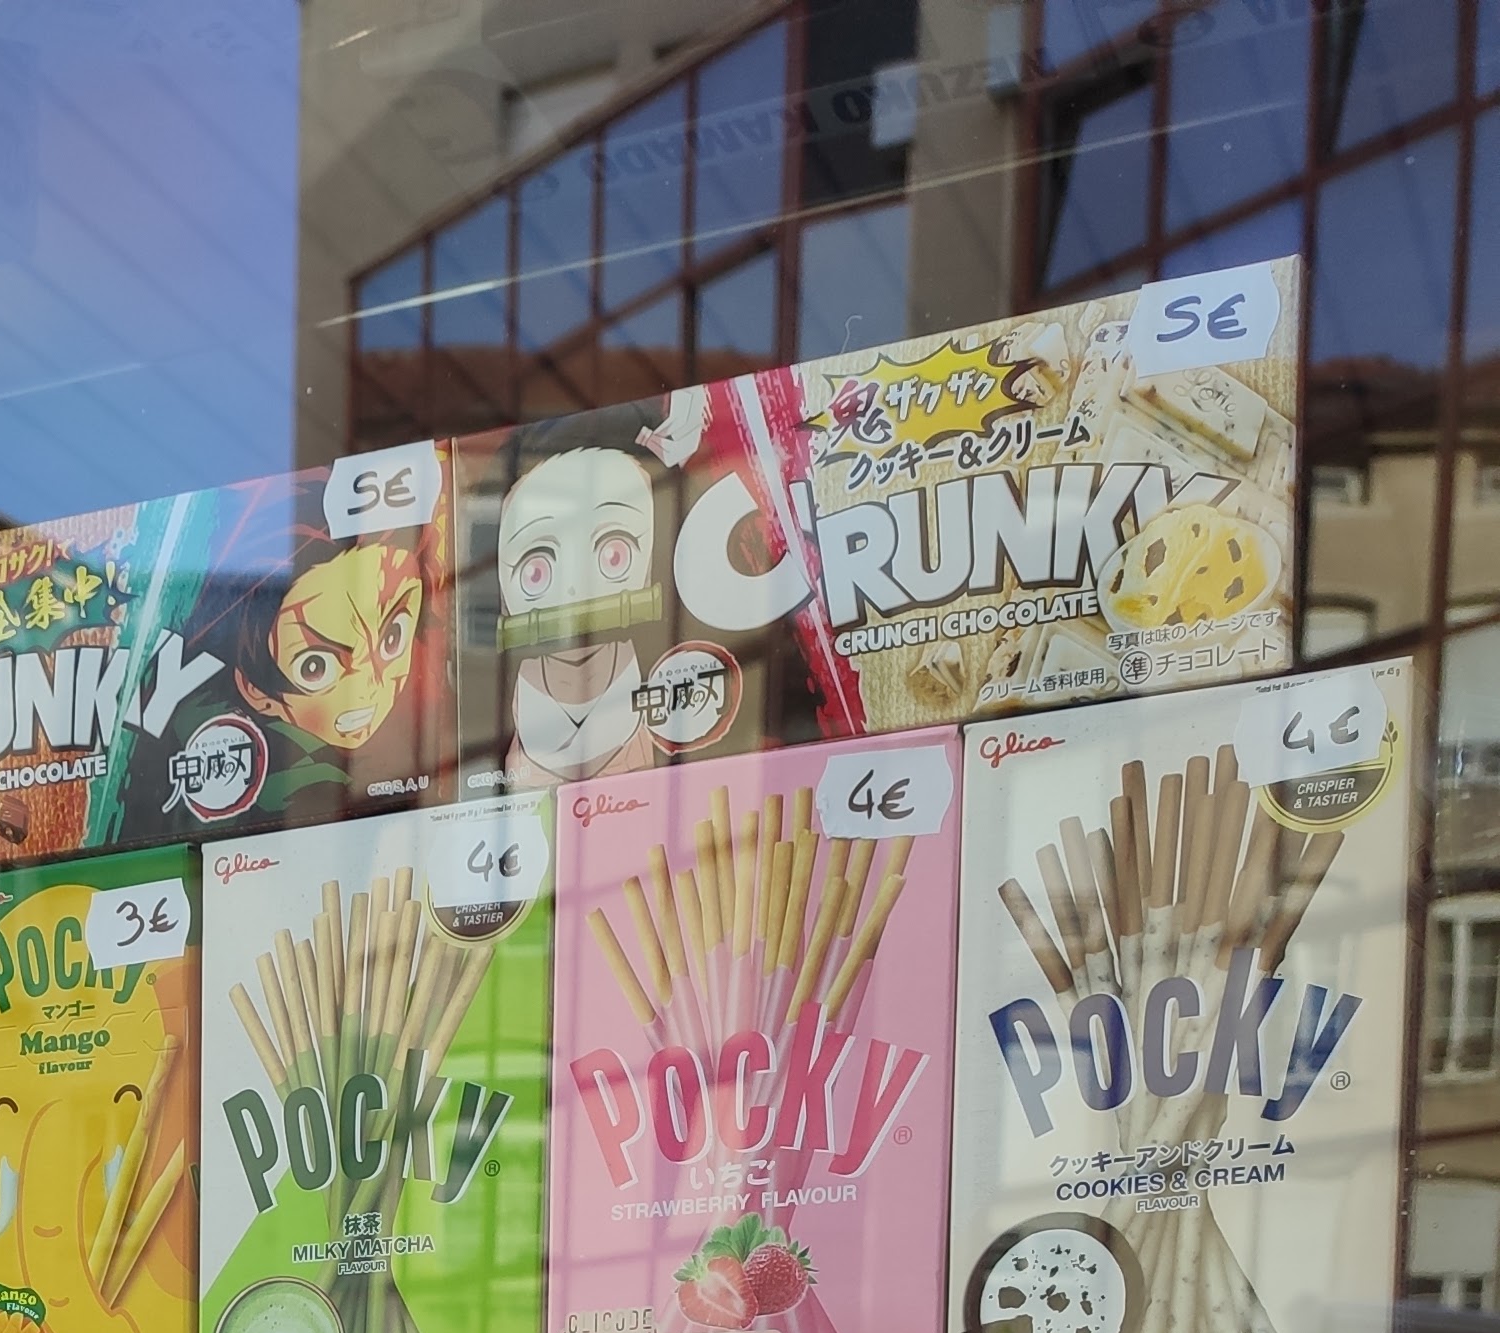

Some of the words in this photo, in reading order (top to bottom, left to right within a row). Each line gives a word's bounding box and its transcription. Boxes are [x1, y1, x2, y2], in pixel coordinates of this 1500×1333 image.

[1155, 292, 1250, 342] 5€
[345, 467, 418, 517] 5€
[674, 463, 1241, 634] CRUNKY
[835, 617, 937, 657] CRUNCH
[942, 591, 1097, 638] CHOCOLATE
[1283, 707, 1361, 755] 4€
[981, 733, 1065, 768] Glico
[848, 775, 915, 819] 4€
[1296, 777, 1356, 796] CRISPIER
[572, 796, 649, 827] Glico
[214, 855, 280, 884] Glico
[468, 841, 521, 882] 4€
[116, 897, 179, 947] 3€
[42, 1002, 95, 1019] マンゴー
[20, 1028, 110, 1055] Mango
[989, 947, 1363, 1138] POCKY
[39, 1059, 92, 1075] flavour
[570, 1002, 930, 1190] POCKY
[222, 1049, 512, 1214] POCKY
[1049, 1135, 1295, 1178] クッキーアンドクリーム
[1056, 1174, 1166, 1201] COOKIES
[1172, 1174, 1189, 1191] &
[1194, 1164, 1285, 1189] CREAM
[611, 1193, 750, 1222] STRAWBERRY
[761, 1186, 858, 1210] FLAVOUR
[1137, 1195, 1199, 1213] FLAVOUR
[344, 1213, 381, 1236] 抹茶
[292, 1240, 349, 1264] MILKY
[354, 1233, 435, 1260] MATCHA
[338, 1260, 386, 1275] FLAVOUR
